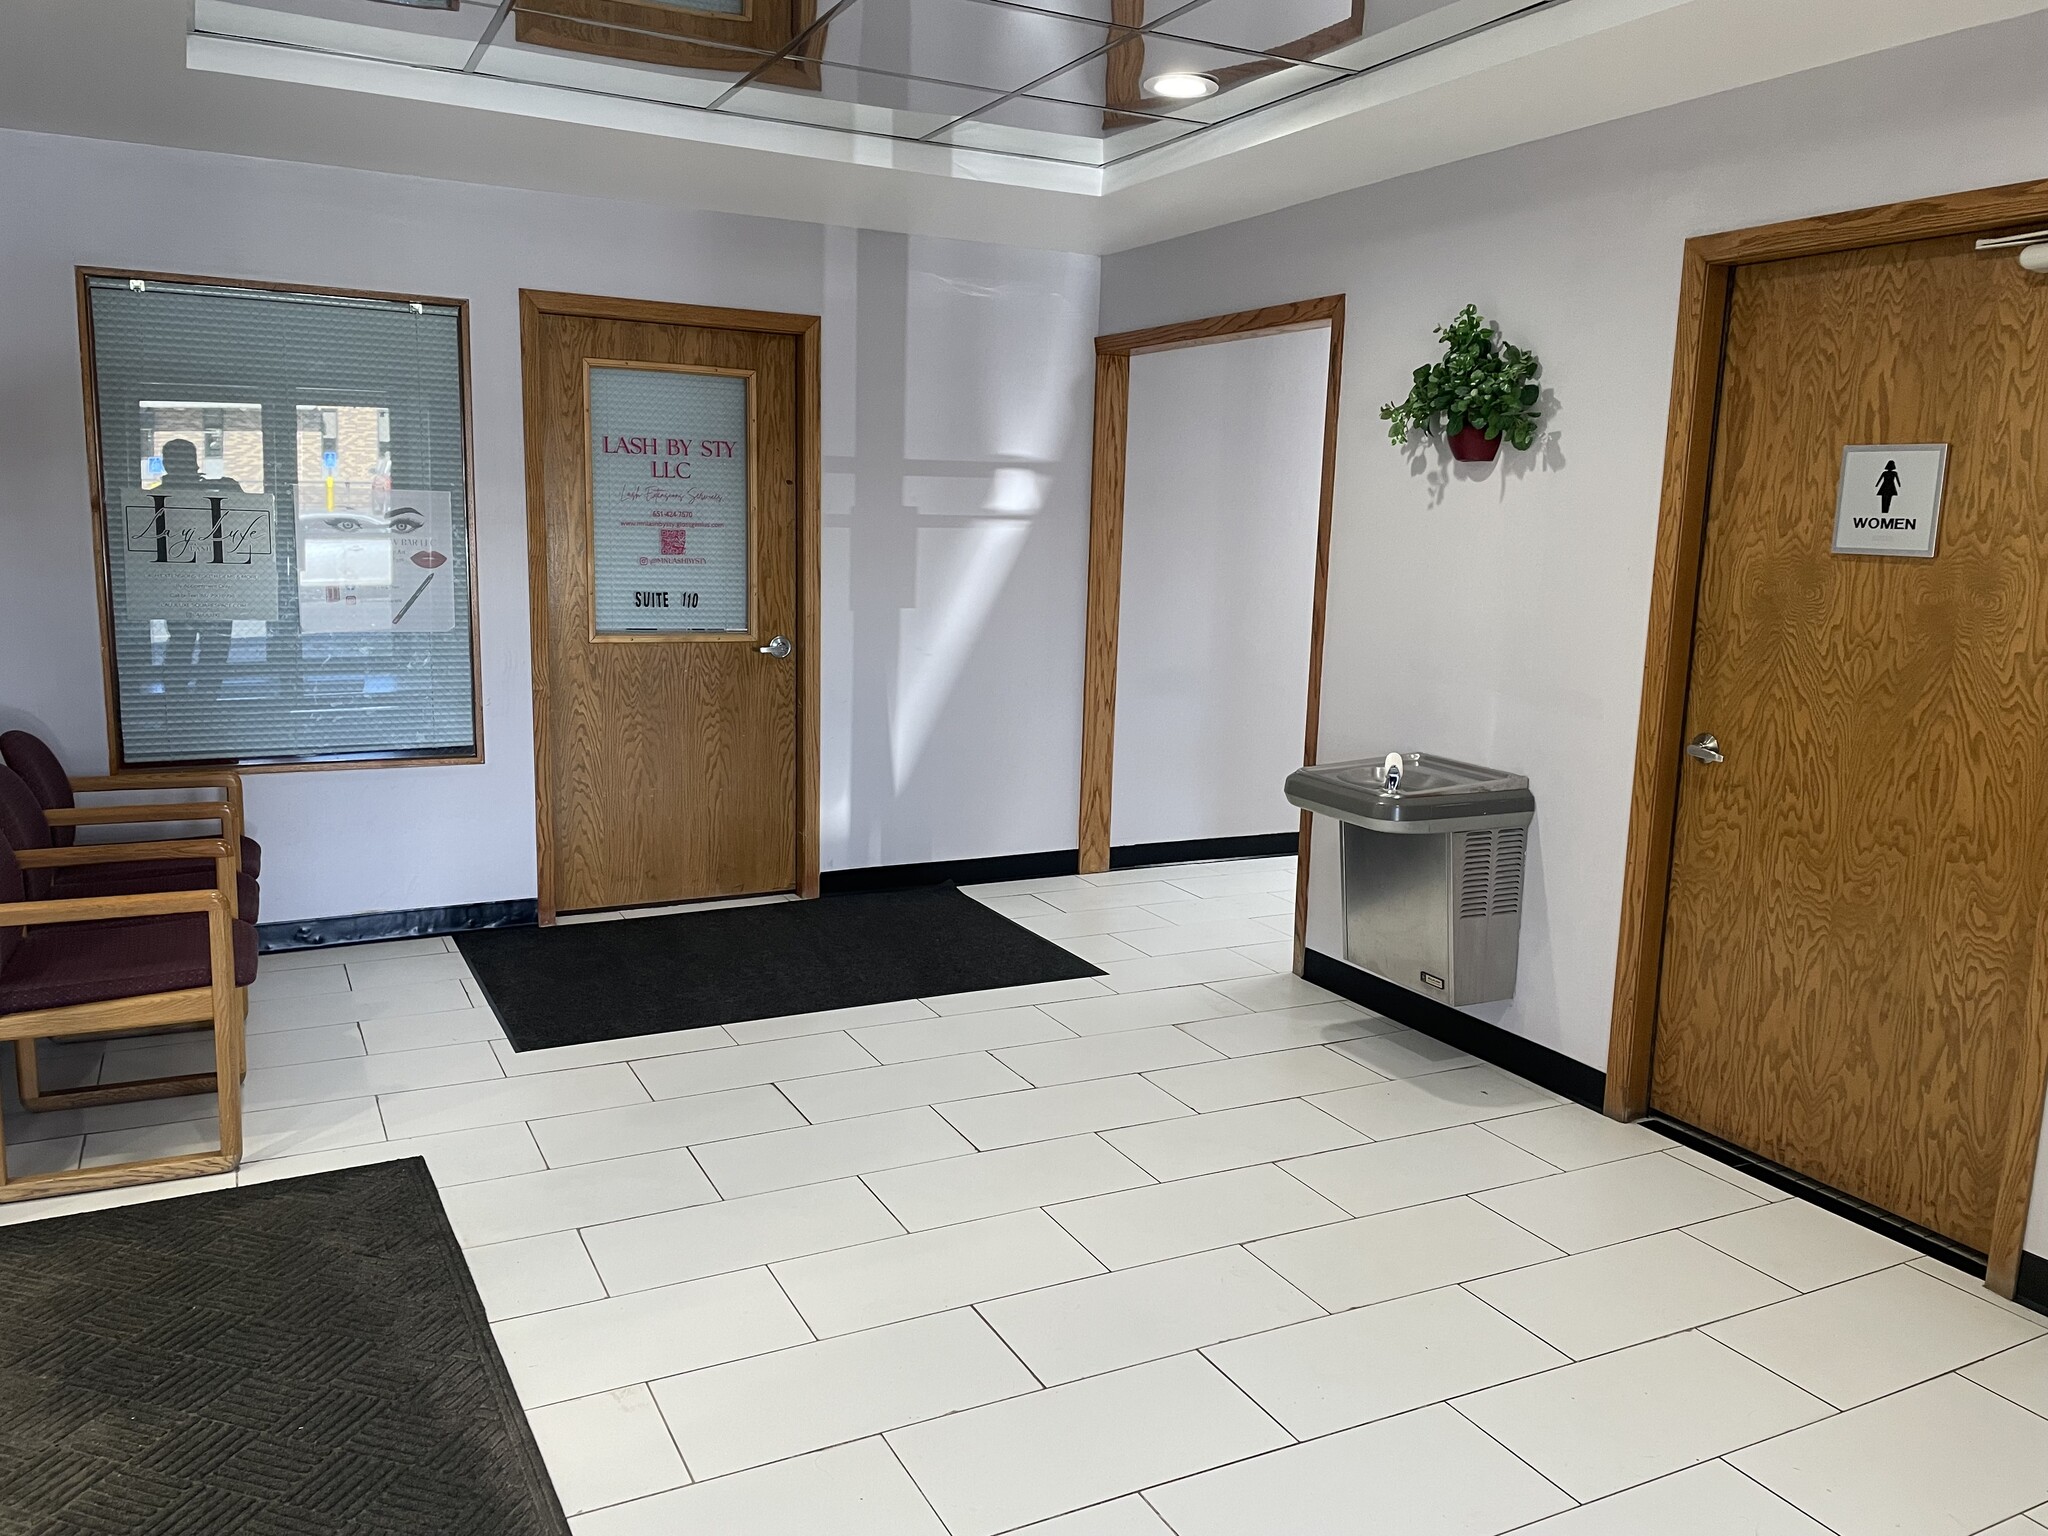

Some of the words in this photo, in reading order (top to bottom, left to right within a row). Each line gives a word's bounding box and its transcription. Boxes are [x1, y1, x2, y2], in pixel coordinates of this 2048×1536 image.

[603, 436, 657, 454] LASH
[667, 438, 693, 456] BY
[701, 440, 737, 458] STY
[651, 461, 692, 479] LLC
[1853, 517, 1917, 530] WOMEN
[635, 591, 669, 608] SUITE
[682, 592, 699, 608] 110
